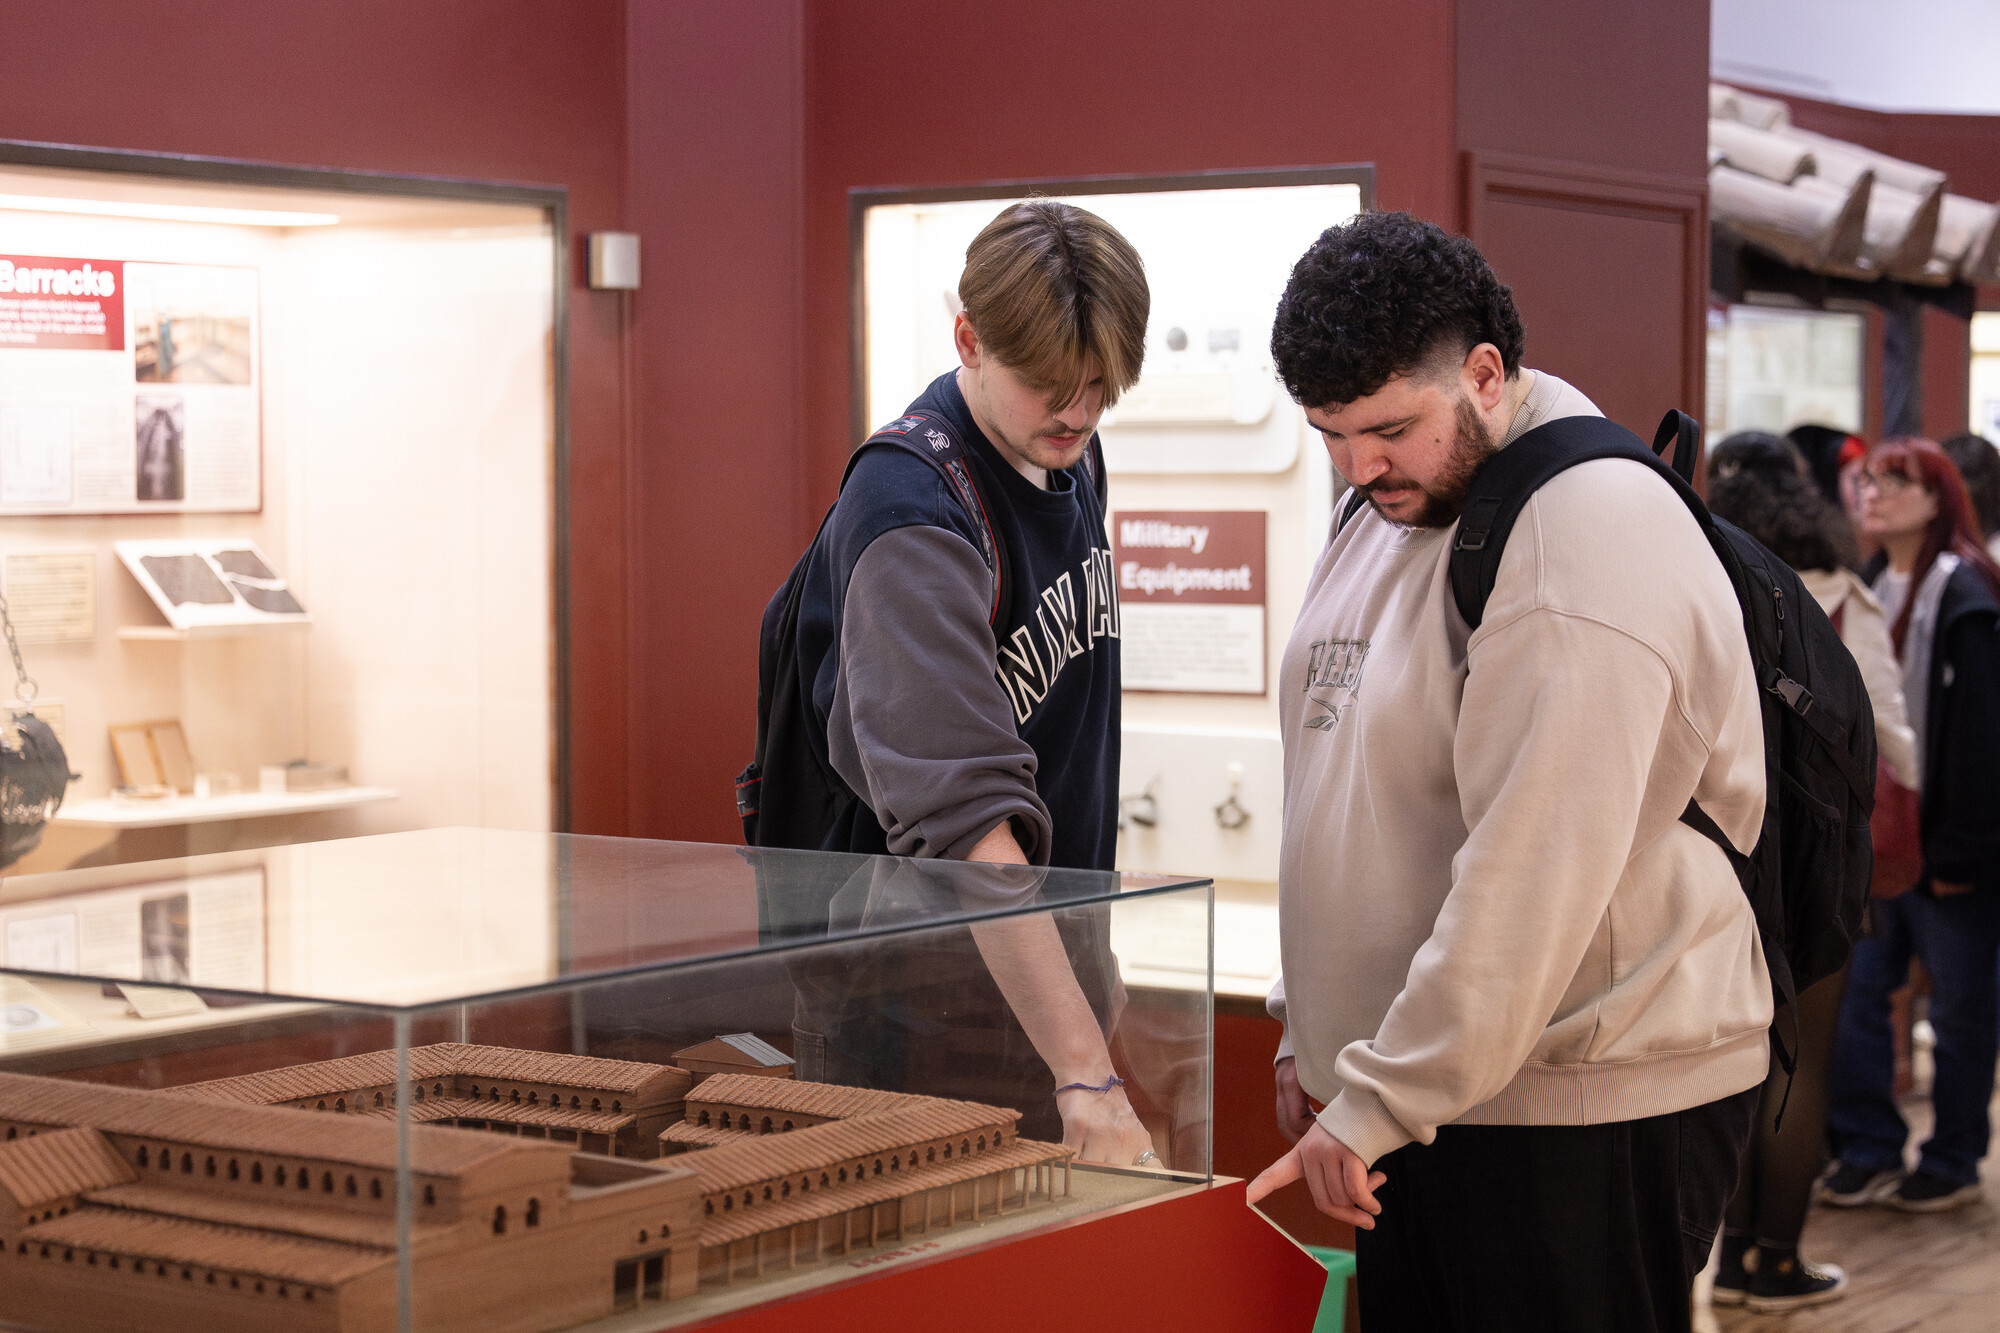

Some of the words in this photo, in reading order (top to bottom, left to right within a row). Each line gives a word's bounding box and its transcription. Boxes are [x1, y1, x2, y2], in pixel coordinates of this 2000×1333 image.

[0, 259, 115, 297] Barracks
[1121, 519, 1209, 554] Military
[1121, 561, 1252, 595] Equipment
